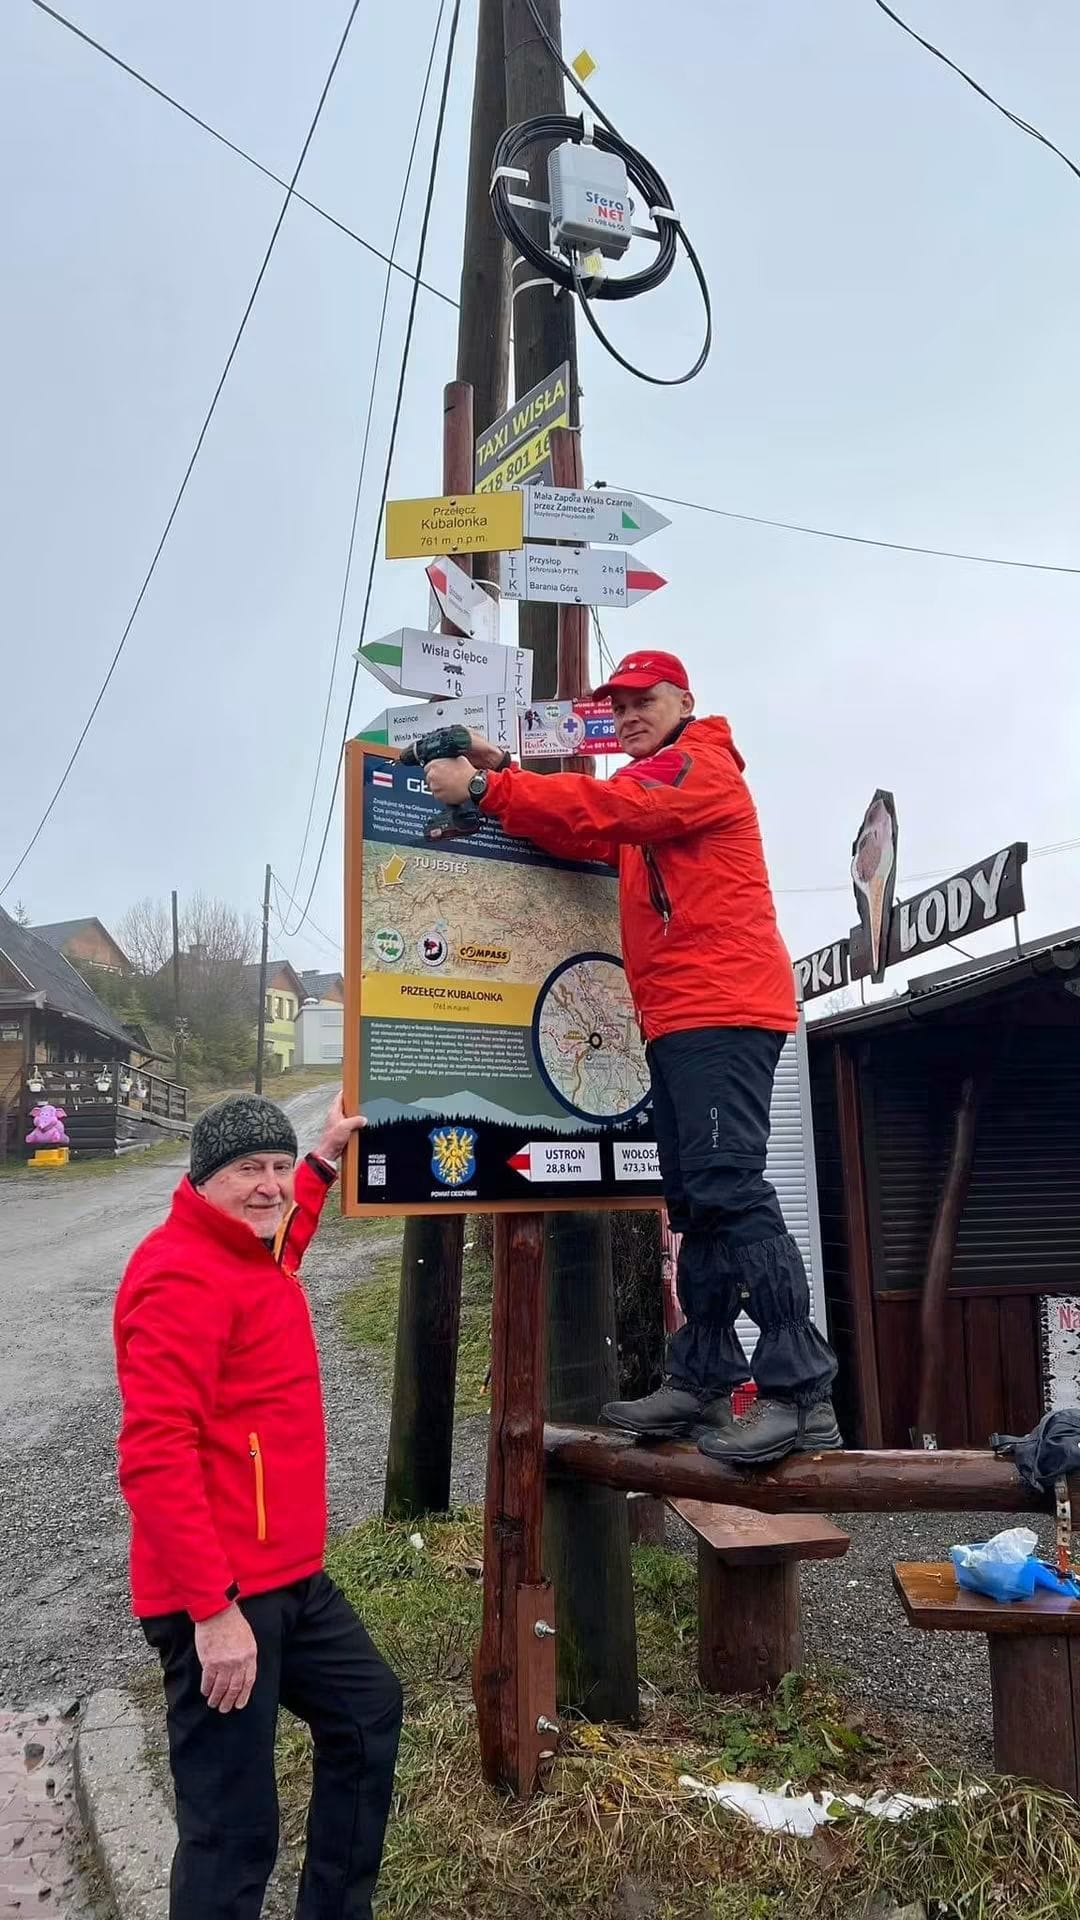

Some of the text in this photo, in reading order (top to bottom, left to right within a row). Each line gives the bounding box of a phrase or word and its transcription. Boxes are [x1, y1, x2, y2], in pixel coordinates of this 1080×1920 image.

[586, 191, 624, 211] Sfera
[598, 205, 624, 222] NET
[477, 380, 565, 466] TAXI WISŁA
[507, 450, 531, 481] 801
[534, 491, 632, 507] Mała Zapora Wisła Czarne
[433, 506, 476, 517] Przełęcz
[534, 502, 595, 513] przez Zameczek
[421, 517, 487, 530] Kubalonka
[420, 536, 438, 547] 761
[529, 555, 624, 574] Przysłop 2 h 45
[529, 581, 578, 593] Barania Góra
[602, 586, 625, 595] 3 h 45
[422, 642, 488, 665] Wisła Głębce
[446, 678, 451, 689] 1
[497, 697, 507, 741] PTTK
[602, 725, 616, 734] 98
[414, 856, 469, 874] TU JESTEŚ
[899, 850, 1010, 953] LODY
[460, 946, 507, 960] COMPASS
[795, 944, 842, 992] PKI
[401, 985, 504, 1002] PRZEŁĘCZ KUBALONKA
[545, 1147, 585, 1160] USTROŃ
[546, 1163, 582, 1174] 28,8 km
[622, 1163, 646, 1173] 473,3
